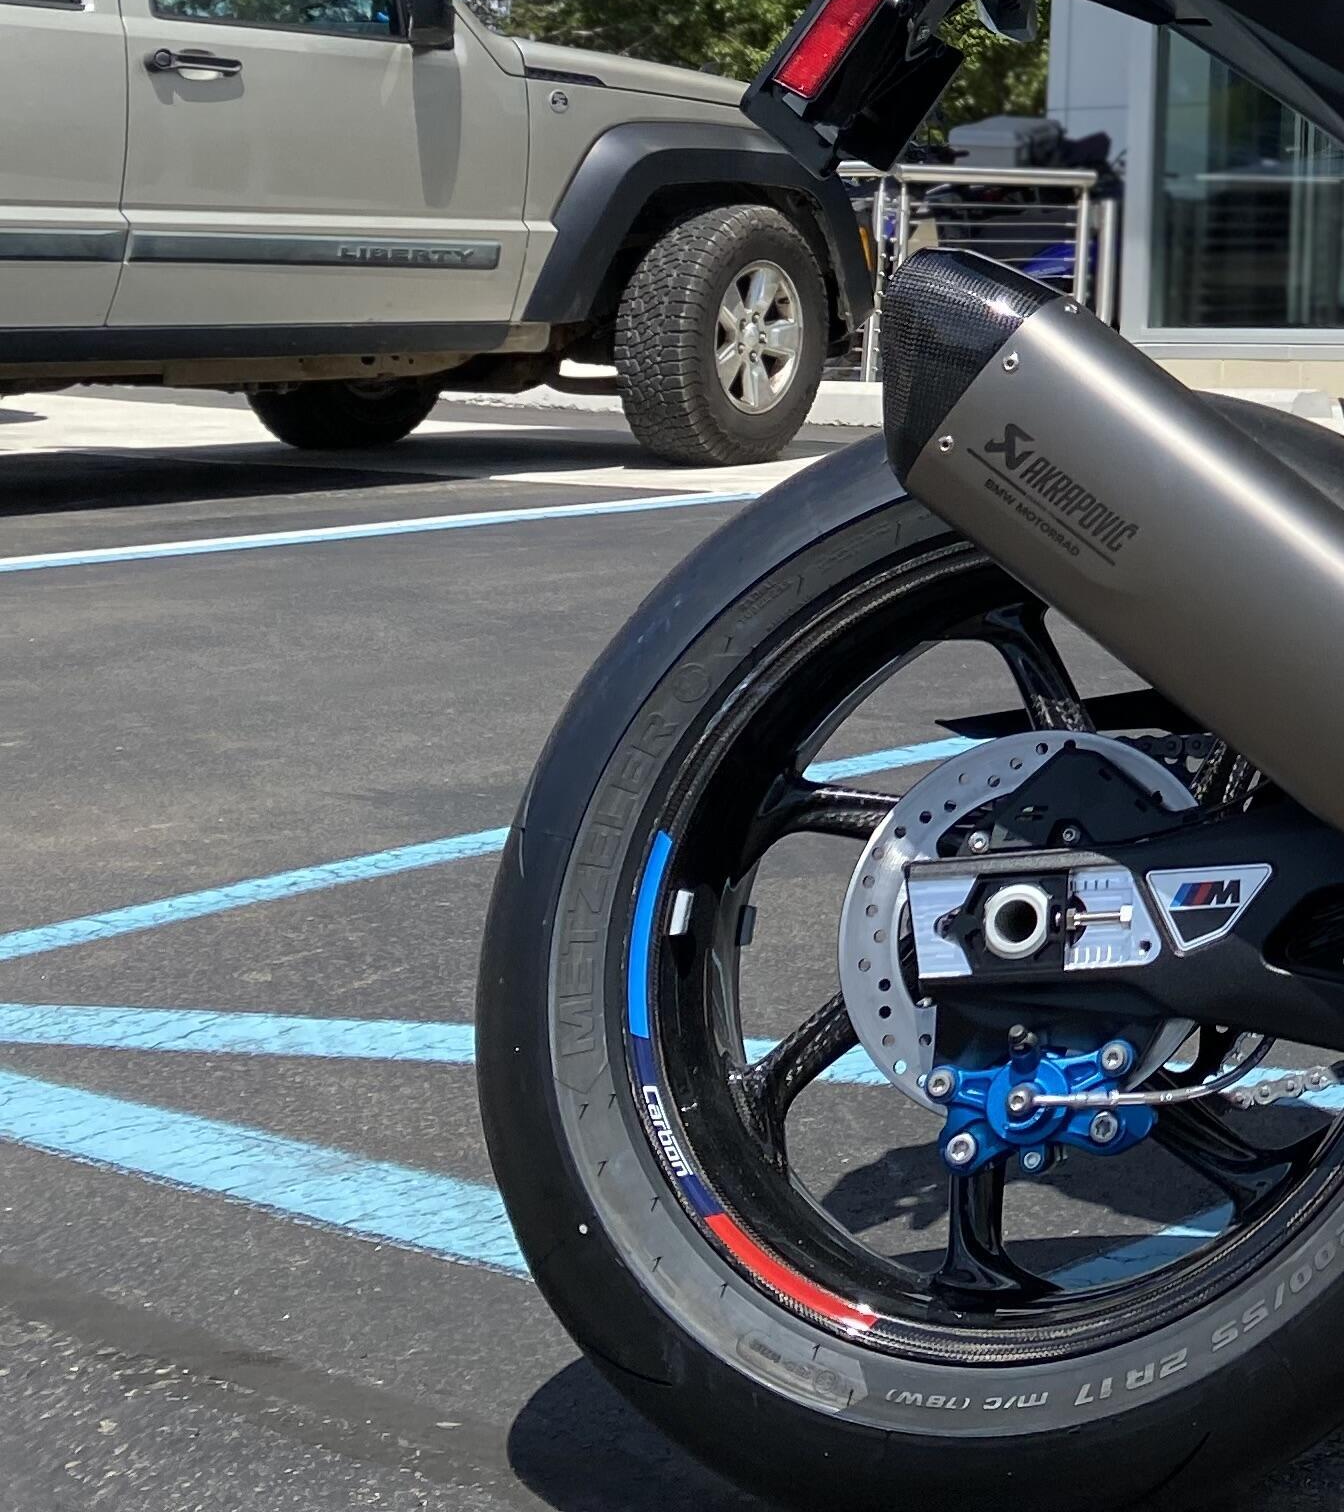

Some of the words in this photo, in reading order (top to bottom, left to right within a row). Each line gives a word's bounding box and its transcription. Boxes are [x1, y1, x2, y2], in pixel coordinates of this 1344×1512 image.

[338, 245, 474, 264] LIBERTY
[984, 478, 1016, 506] BMW
[1015, 502, 1081, 557] MOTORRAD
[556, 713, 679, 1059] METZELER
[642, 1085, 694, 1177] Carbon
[885, 1388, 970, 1410] (78W)
[1074, 1377, 1113, 1407] 17
